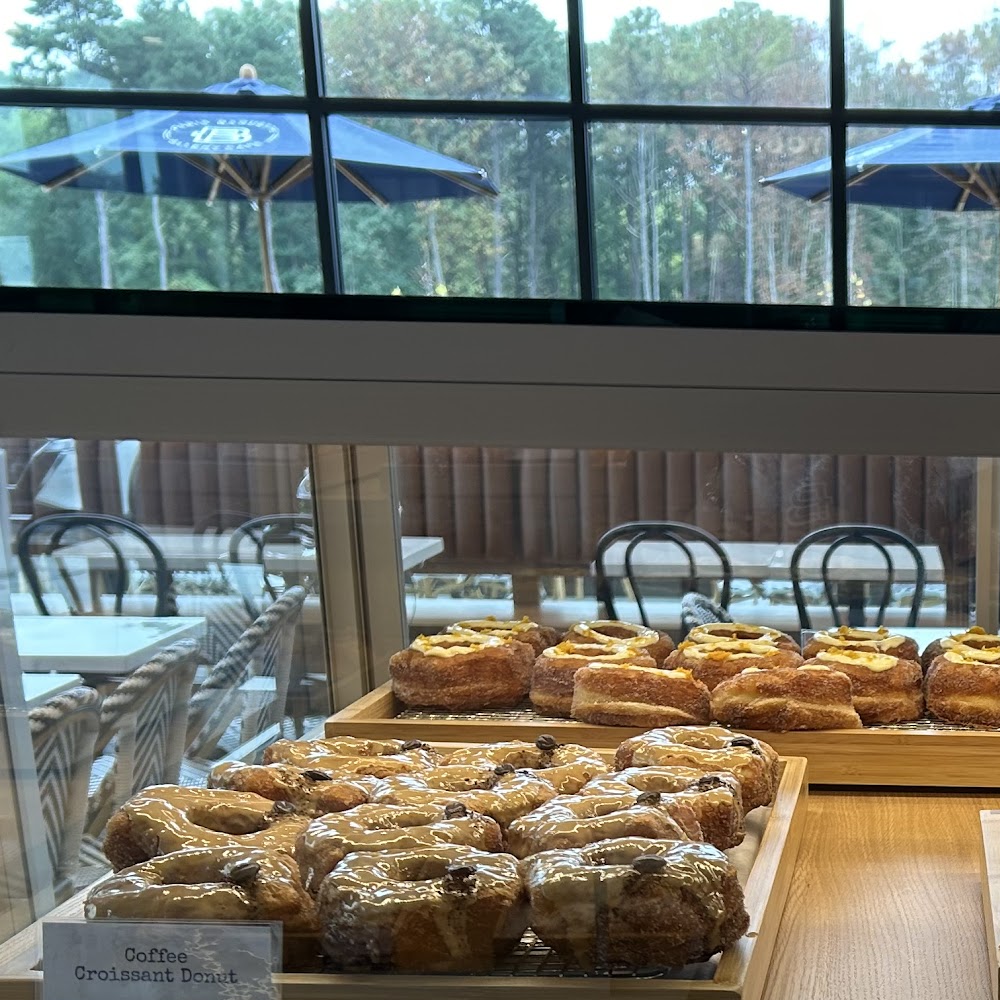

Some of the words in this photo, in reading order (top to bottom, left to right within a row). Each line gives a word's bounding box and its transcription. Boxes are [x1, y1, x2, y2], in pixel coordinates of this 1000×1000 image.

[125, 948, 188, 963] Coffee
[75, 965, 175, 982] Croissant
[181, 968, 239, 984] Donut
